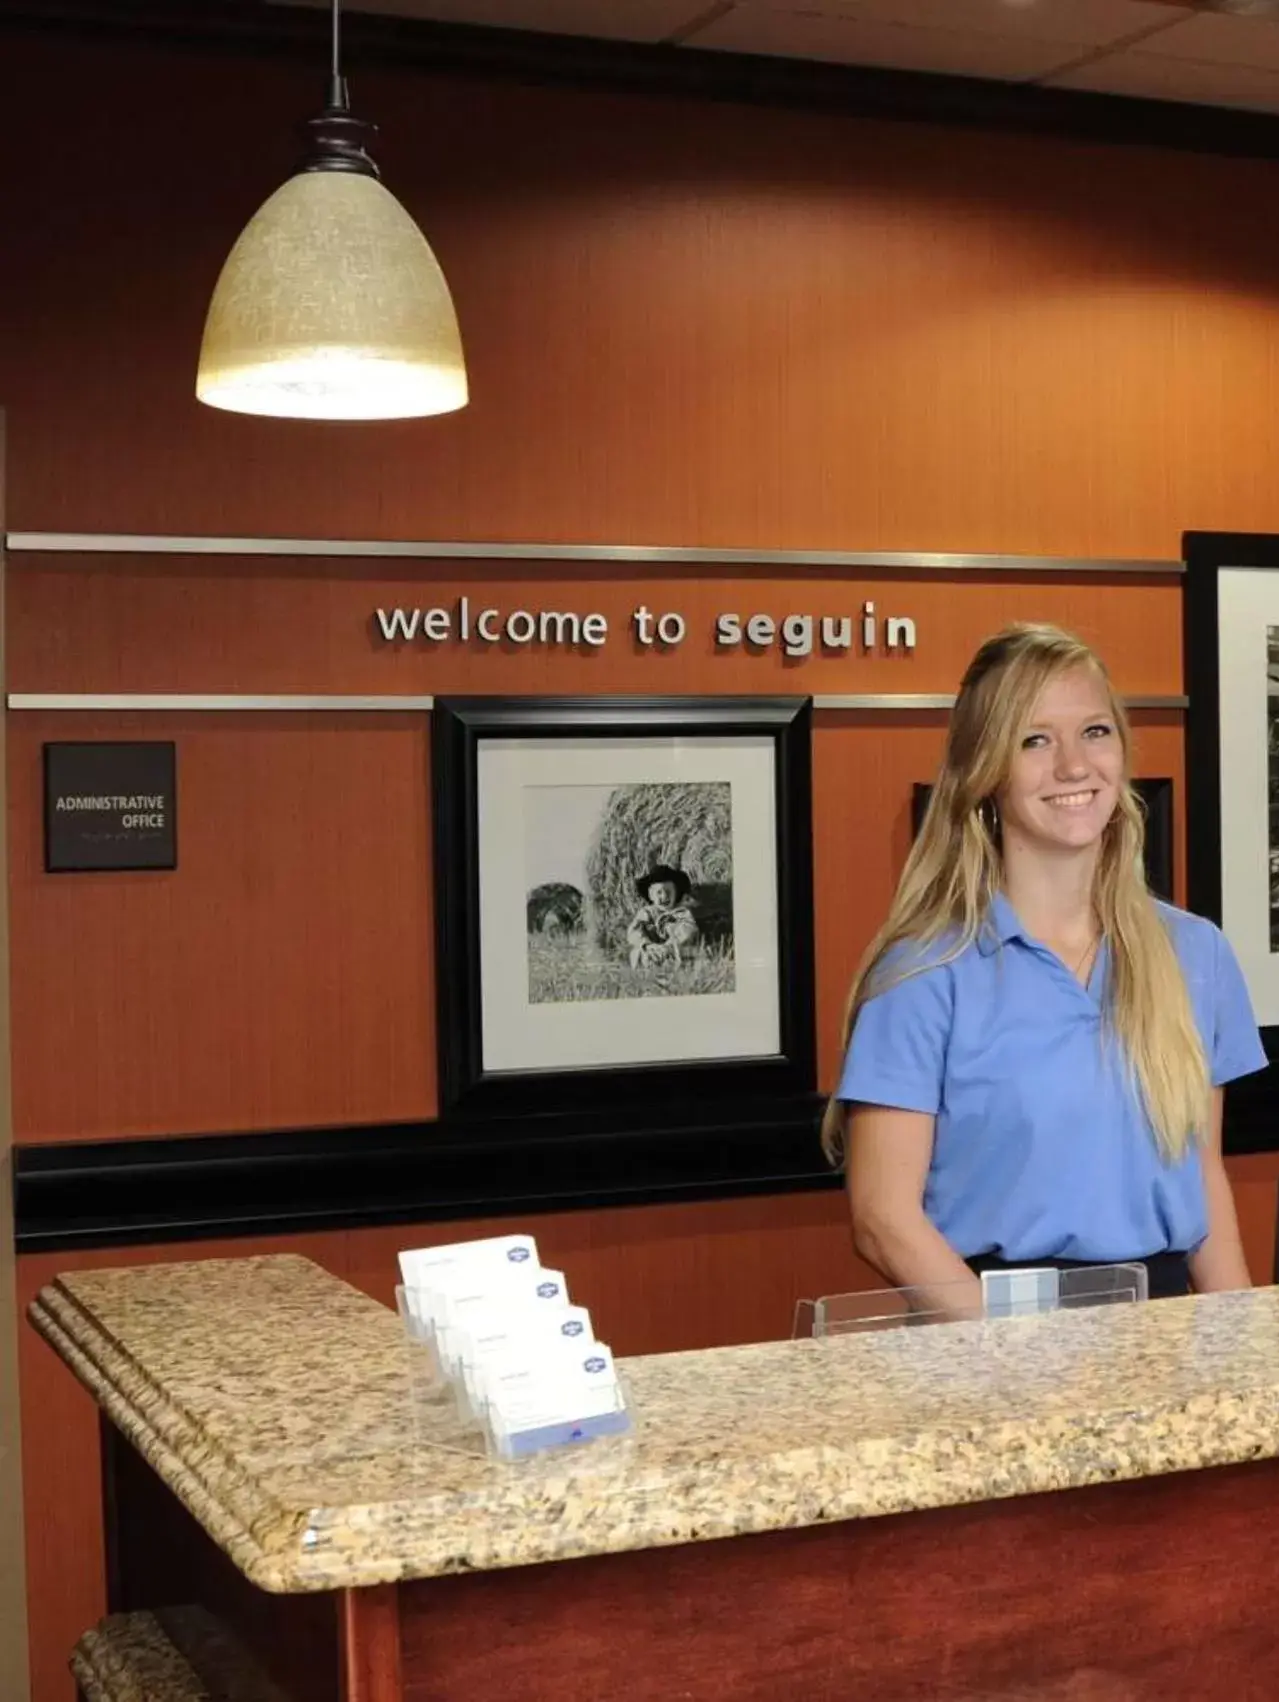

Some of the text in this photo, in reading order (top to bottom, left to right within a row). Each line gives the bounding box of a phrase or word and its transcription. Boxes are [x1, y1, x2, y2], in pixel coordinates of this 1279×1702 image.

[376, 597, 917, 655] welcome to seguin
[56, 797, 164, 811] ADMINISTRATIVE
[122, 814, 165, 828] OFFICE
